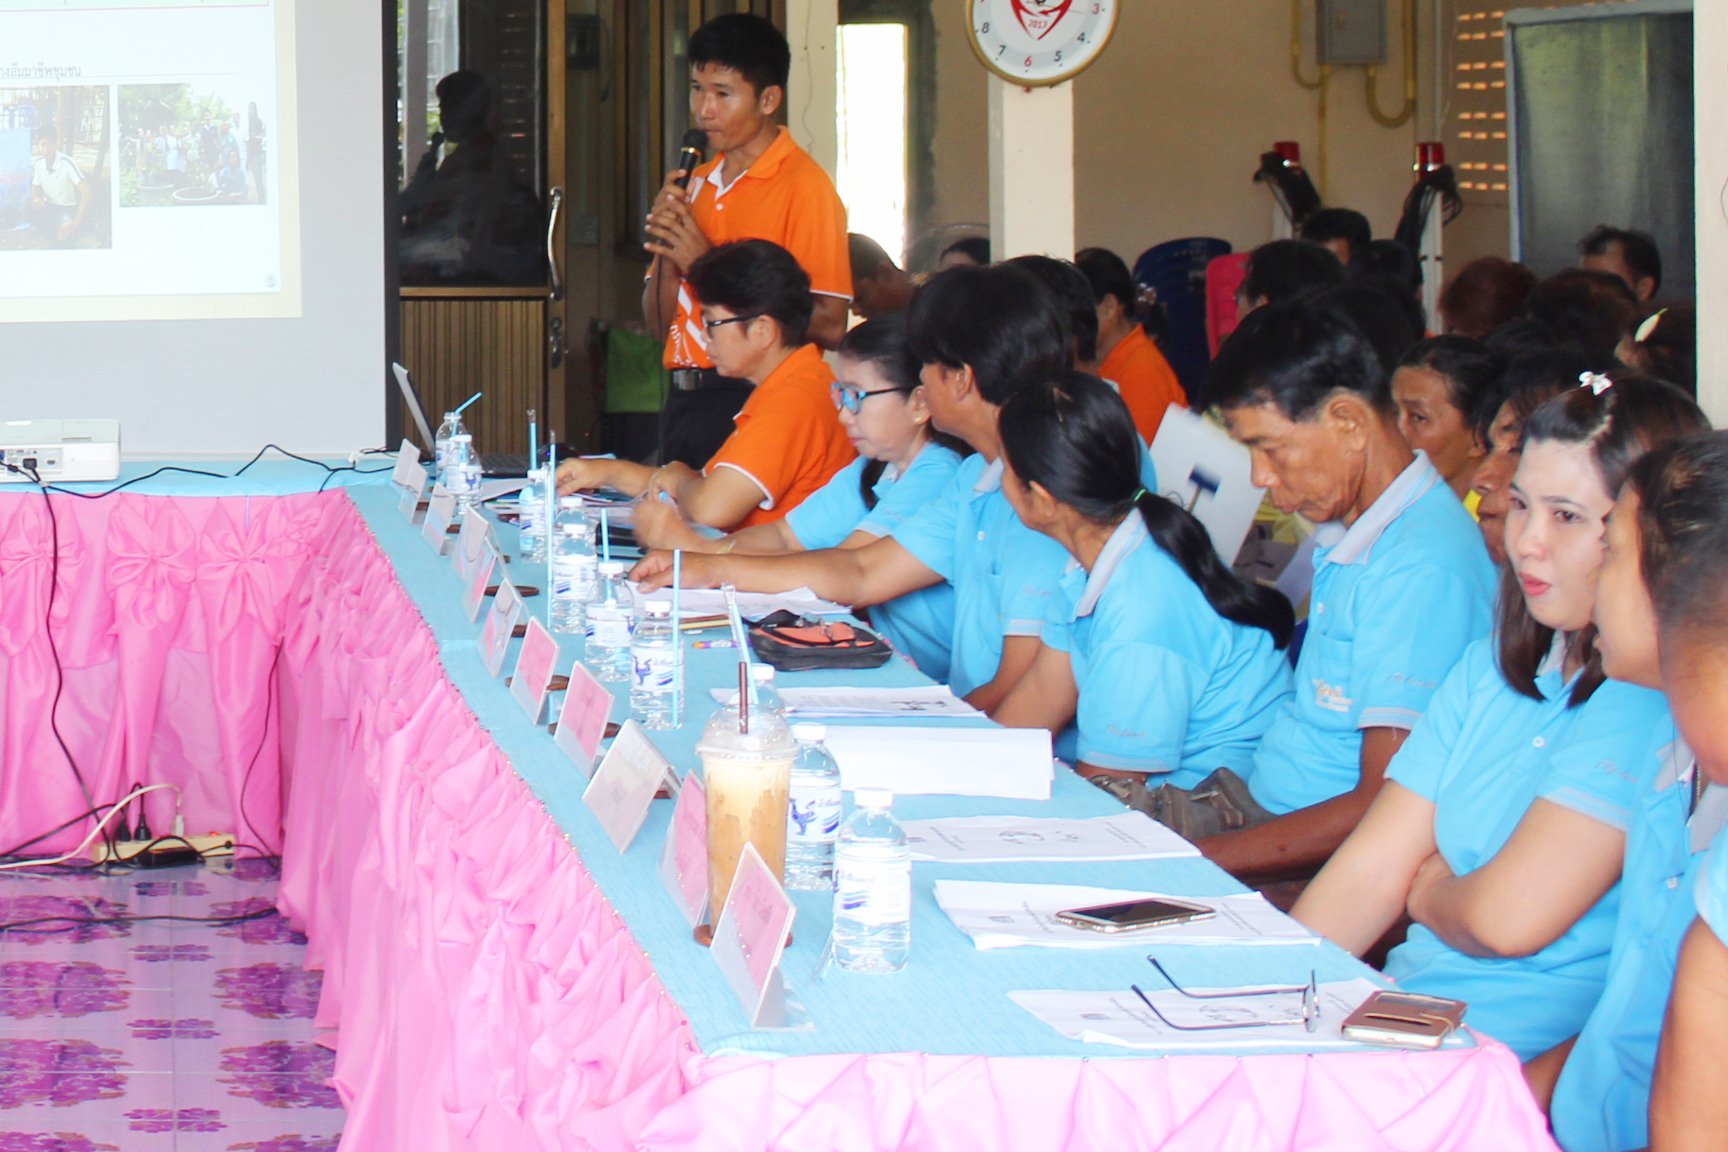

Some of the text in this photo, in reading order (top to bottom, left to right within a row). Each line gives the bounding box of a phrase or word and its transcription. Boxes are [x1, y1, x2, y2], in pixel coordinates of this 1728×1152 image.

[1091, 3, 1100, 15] 3
[981, 22, 990, 34] 8
[1077, 31, 1086, 44] 4
[998, 45, 1007, 56] 7
[1053, 50, 1063, 62] 5
[1024, 55, 1033, 67] 6
